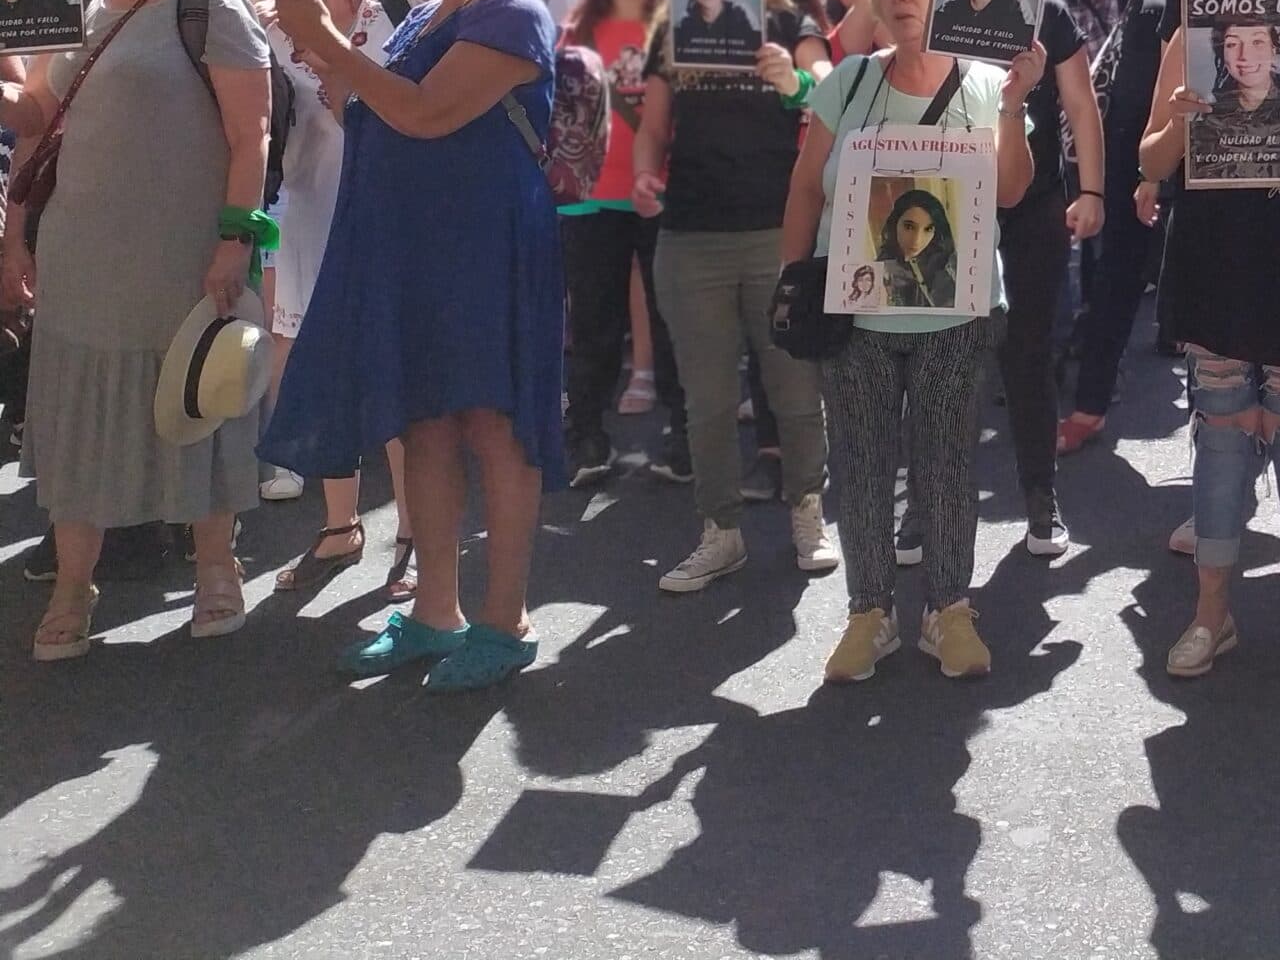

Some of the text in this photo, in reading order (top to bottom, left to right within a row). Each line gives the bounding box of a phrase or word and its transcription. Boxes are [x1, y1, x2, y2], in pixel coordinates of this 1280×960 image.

[37, 16, 59, 24] FALLO
[39, 27, 78, 35] FEMICIDIO
[952, 24, 1014, 39] NULIDAD AL FALLO
[941, 35, 974, 45] CONDENA
[1219, 134, 1261, 145] NULIDAD
[1265, 135, 1277, 144] AL
[851, 139, 918, 152] AGUSTINA
[919, 140, 977, 154] FREDES
[1195, 154, 1201, 163] Y
[1205, 152, 1253, 163] CONDENA
[1257, 152, 1277, 161] POR
[968, 180, 982, 312] JUSTICIA
